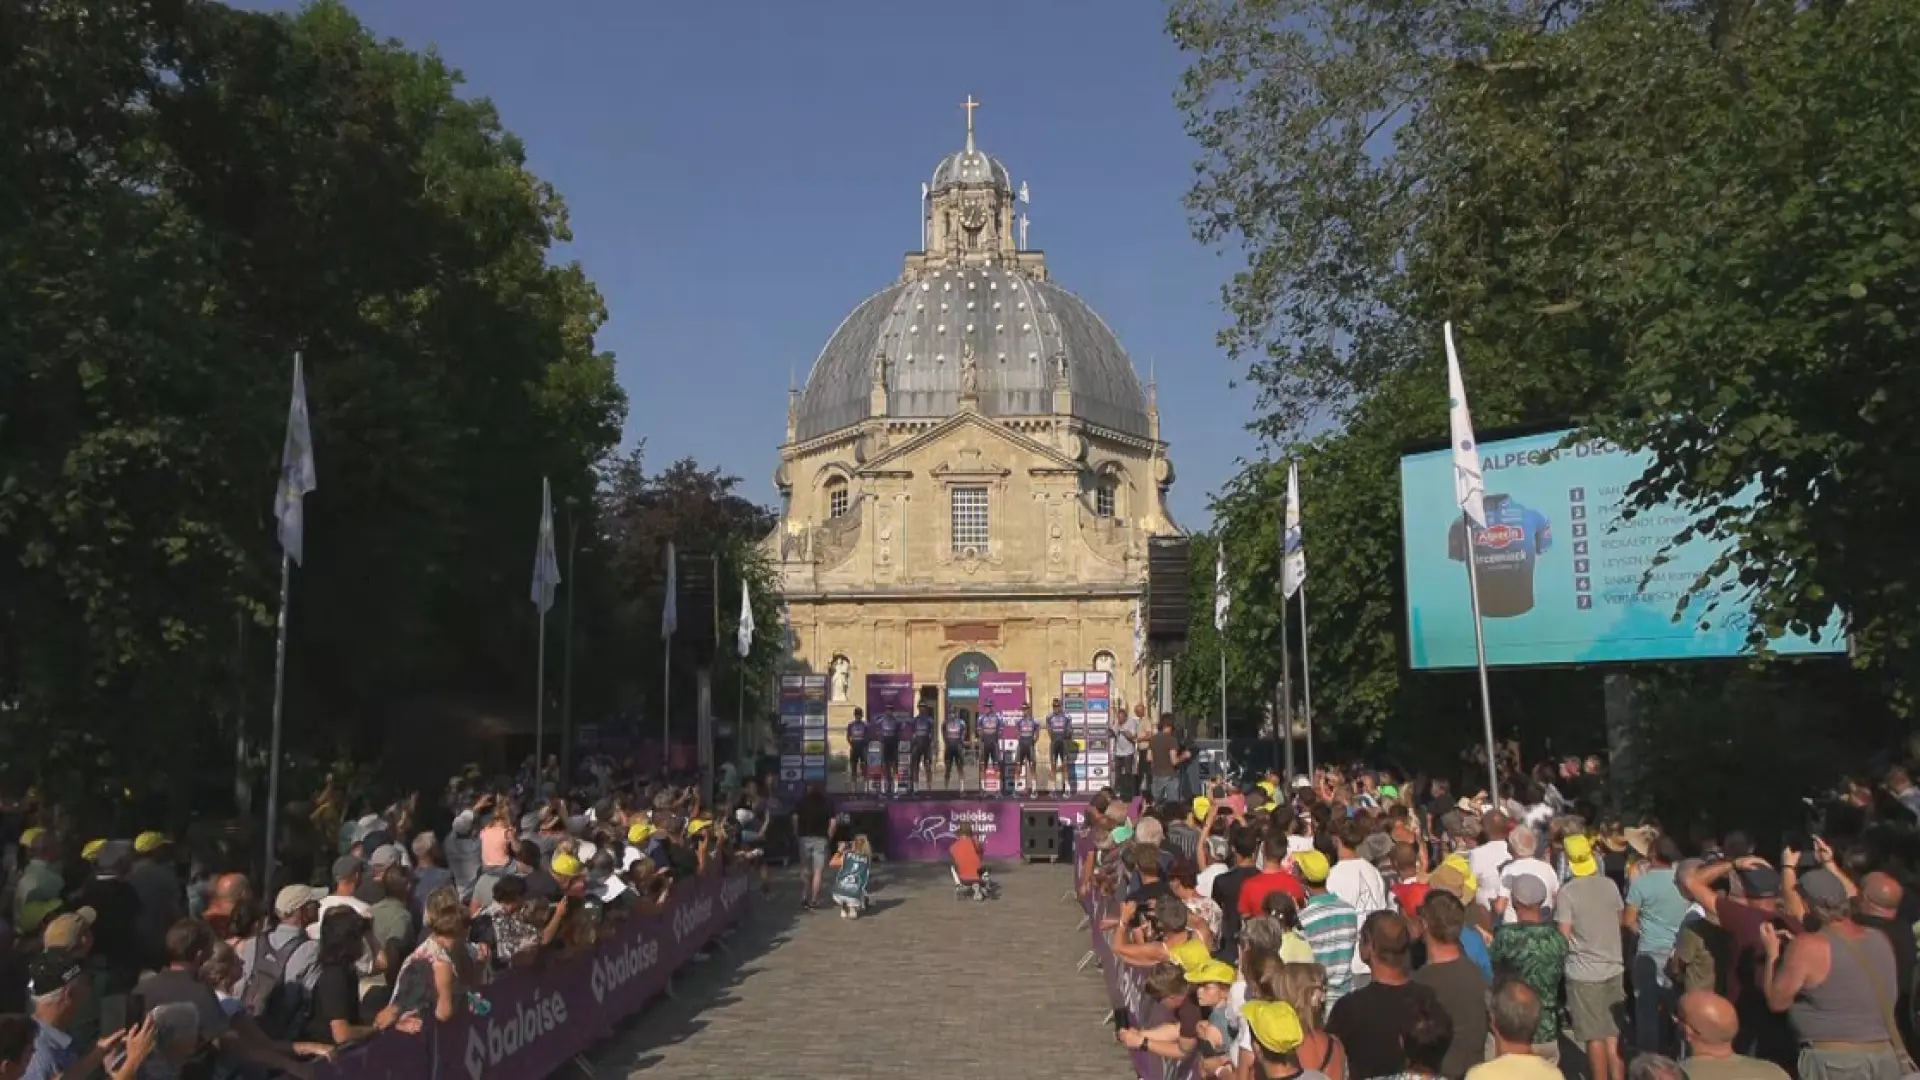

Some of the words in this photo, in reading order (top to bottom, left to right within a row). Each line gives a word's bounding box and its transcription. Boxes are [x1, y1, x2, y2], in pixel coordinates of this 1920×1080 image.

[950, 809, 995, 822] baloise
[604, 931, 658, 992] baloise
[487, 987, 567, 1066] baloise
